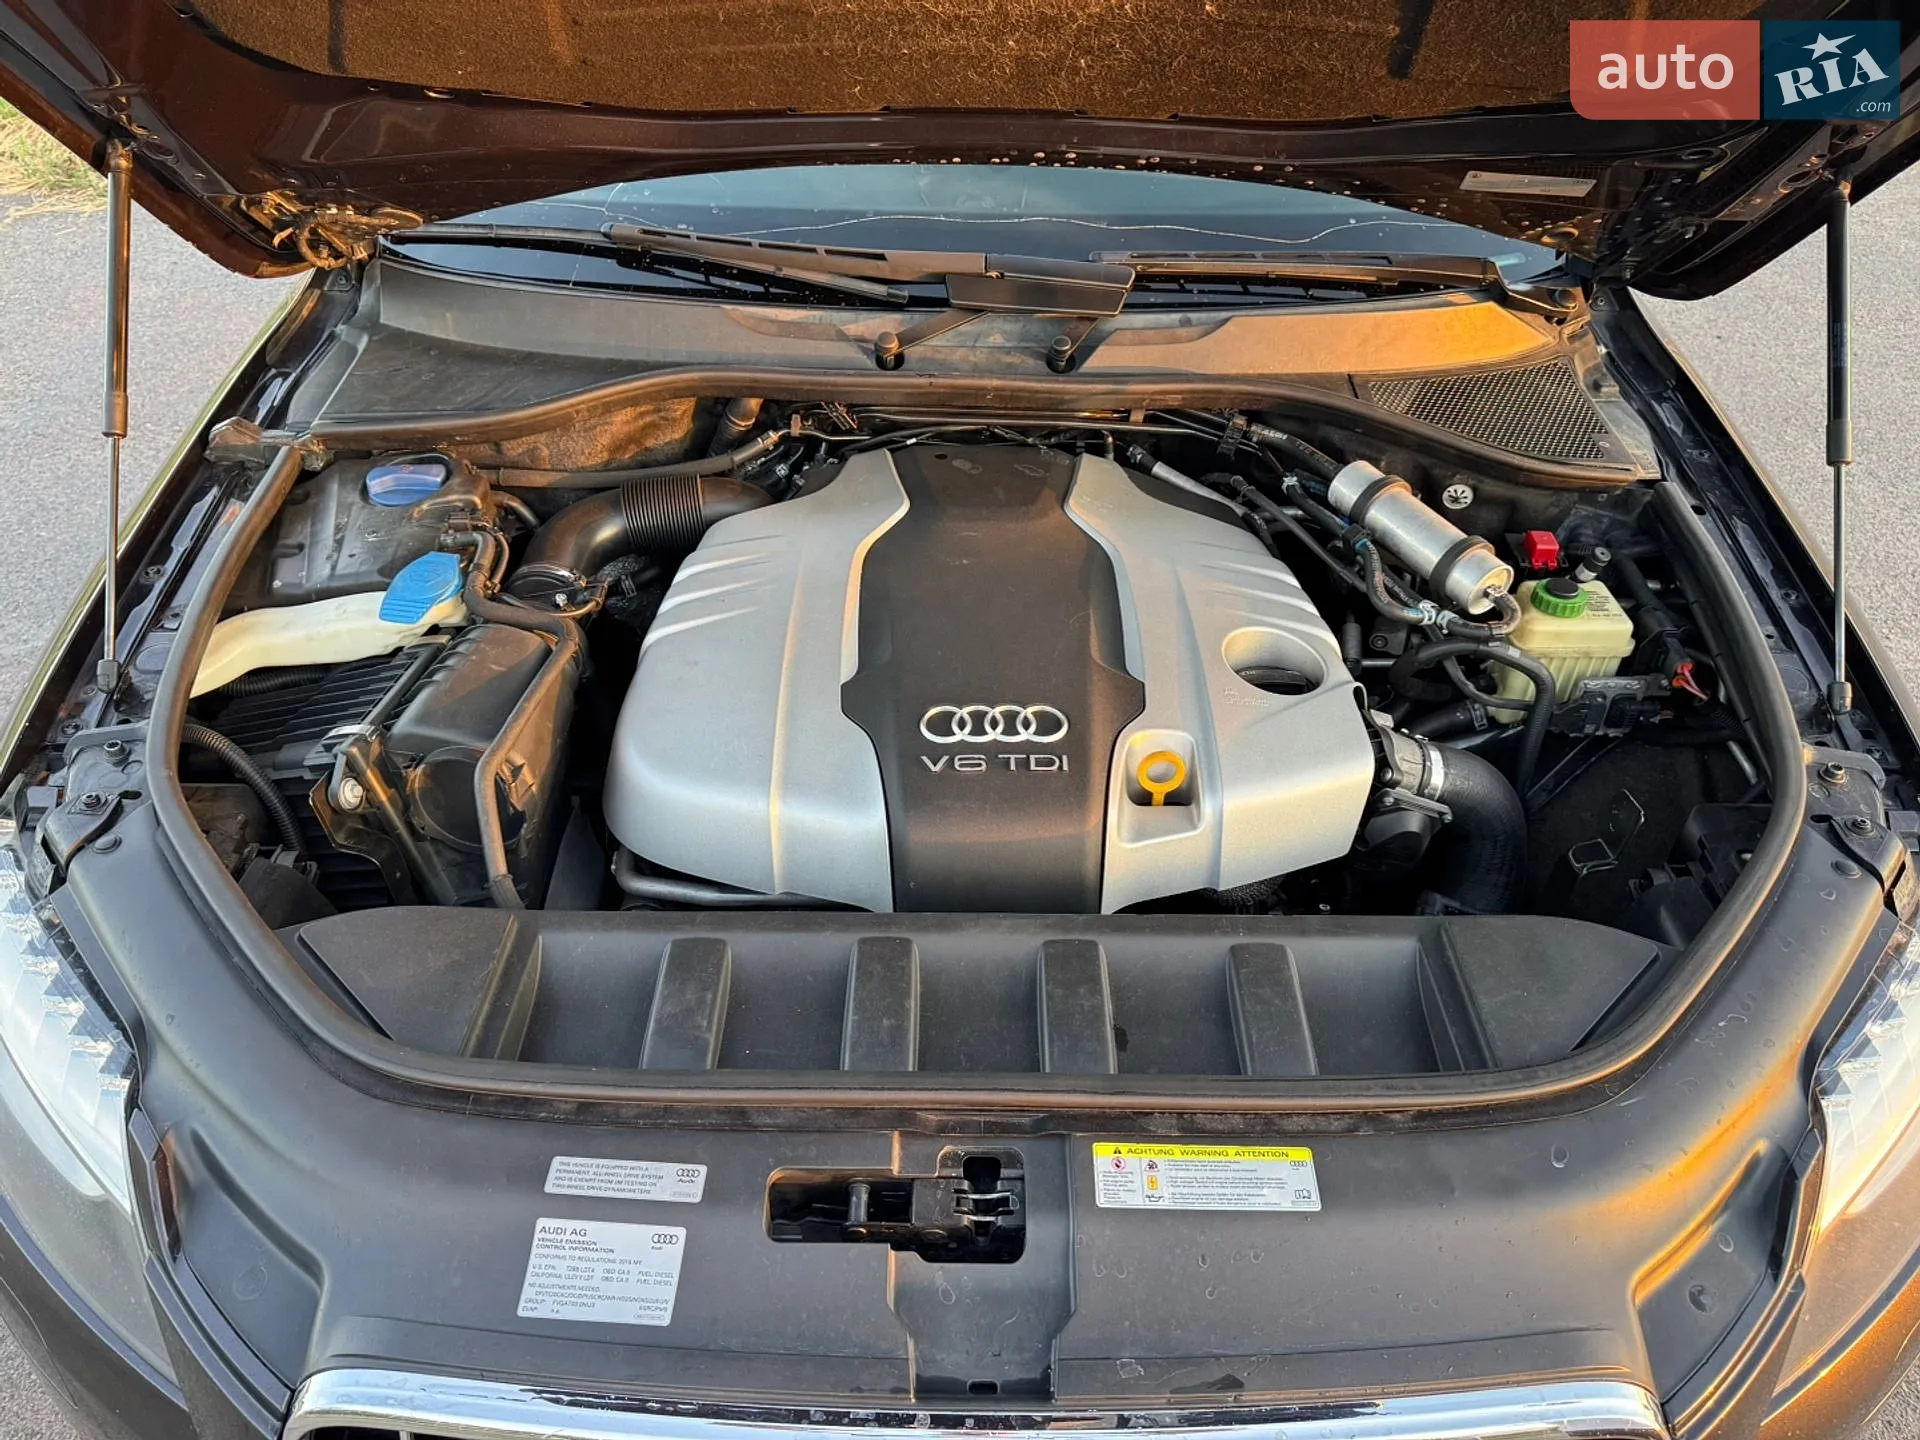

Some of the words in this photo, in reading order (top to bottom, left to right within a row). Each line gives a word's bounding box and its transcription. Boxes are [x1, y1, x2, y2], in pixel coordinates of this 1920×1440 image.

[920, 754, 987, 773] V6
[998, 754, 1069, 773] TDI
[1127, 1148, 1175, 1156] ACHTUNG
[1180, 1149, 1229, 1157] WARNING
[1234, 1150, 1289, 1158] ATTENTION
[538, 1226, 567, 1236] AUDI
[569, 1228, 587, 1237] AG
